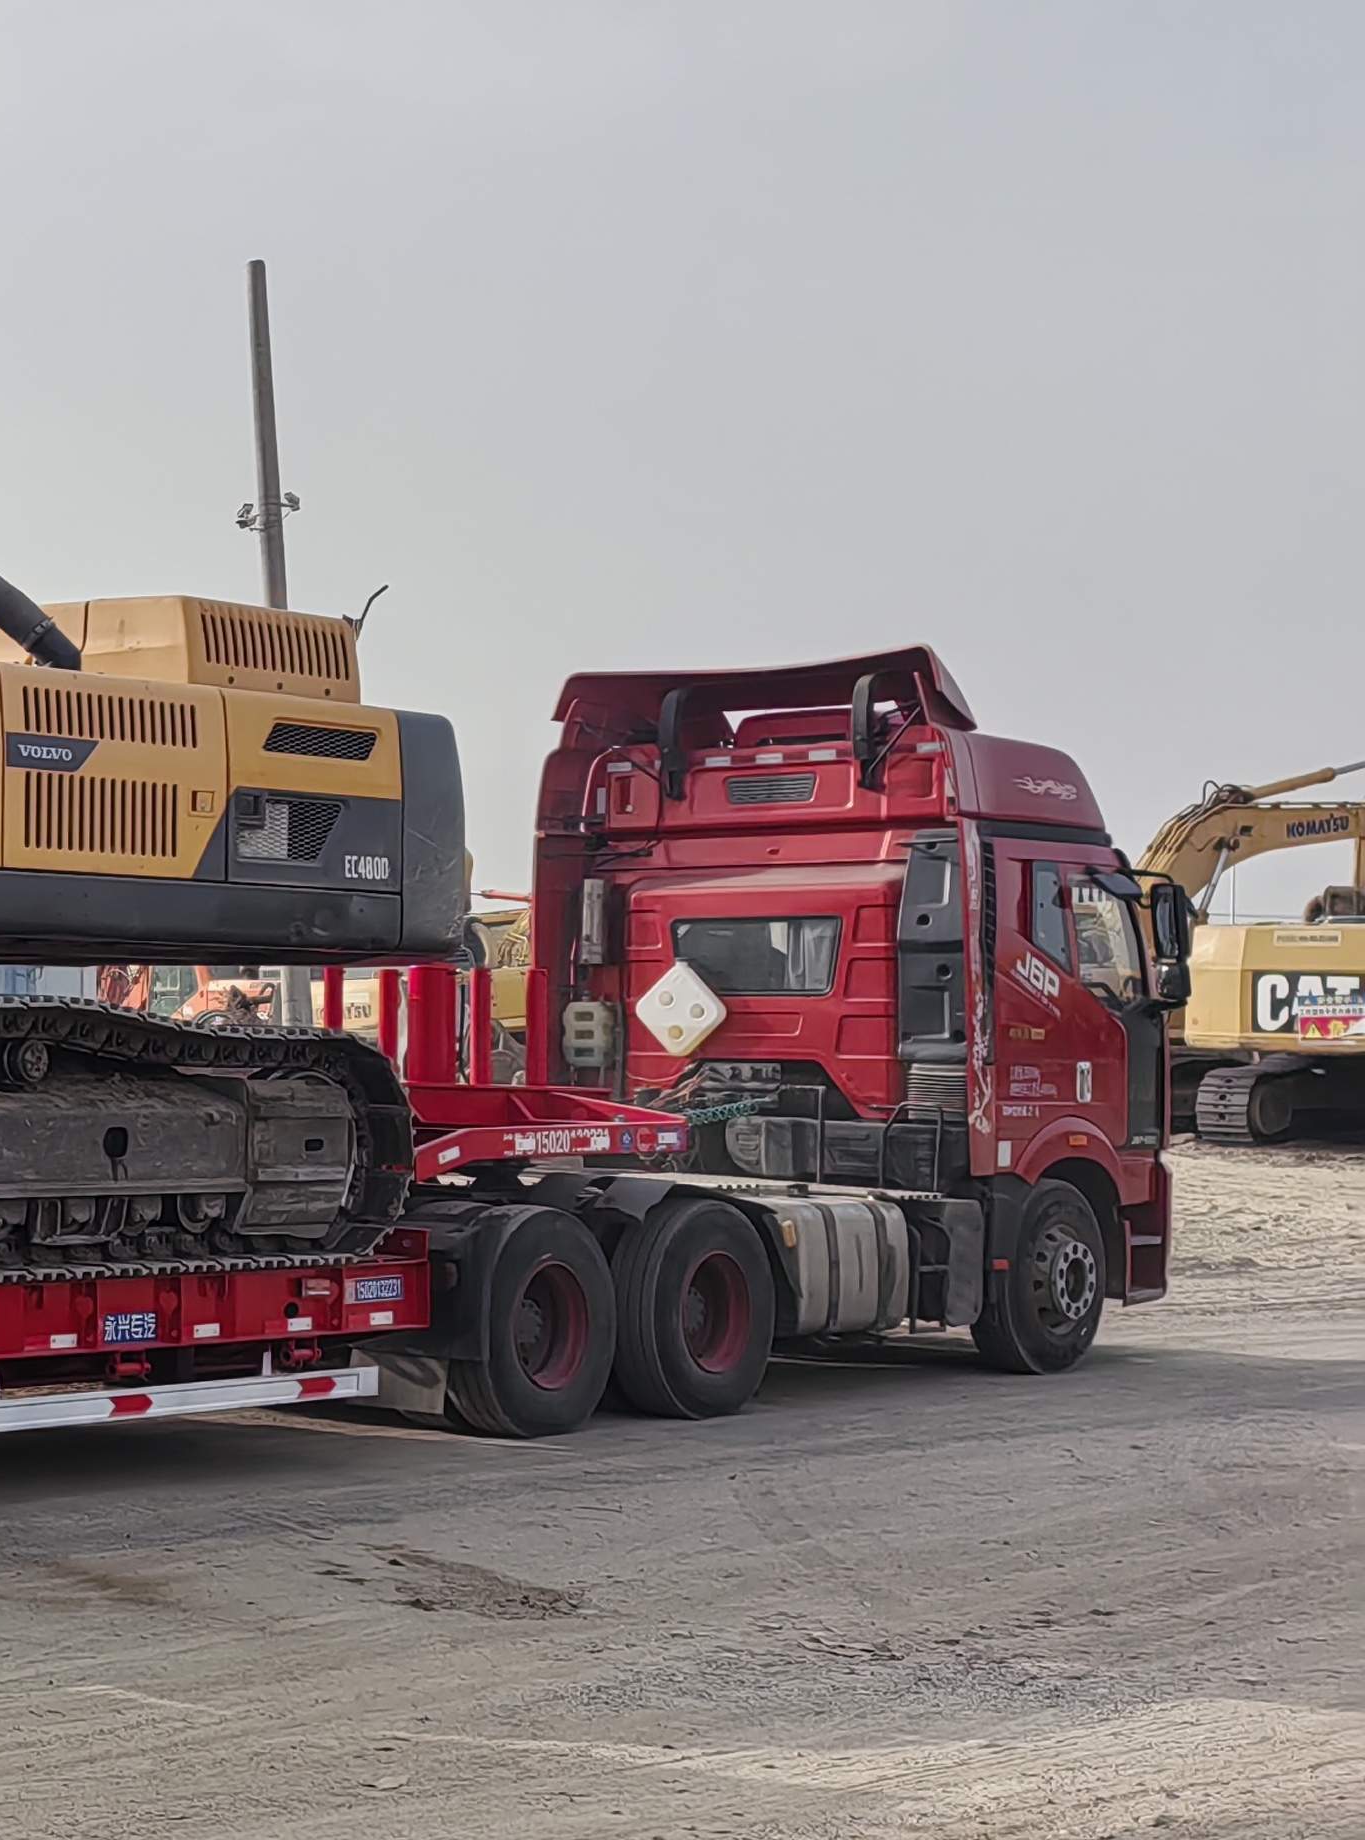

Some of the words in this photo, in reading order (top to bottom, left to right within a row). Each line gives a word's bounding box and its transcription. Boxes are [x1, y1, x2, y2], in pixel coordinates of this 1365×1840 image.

[17, 743, 73, 762] VOLVO
[1286, 813, 1349, 839] KOMATSU
[344, 854, 389, 880] EC480D
[1016, 951, 1060, 998] J6P
